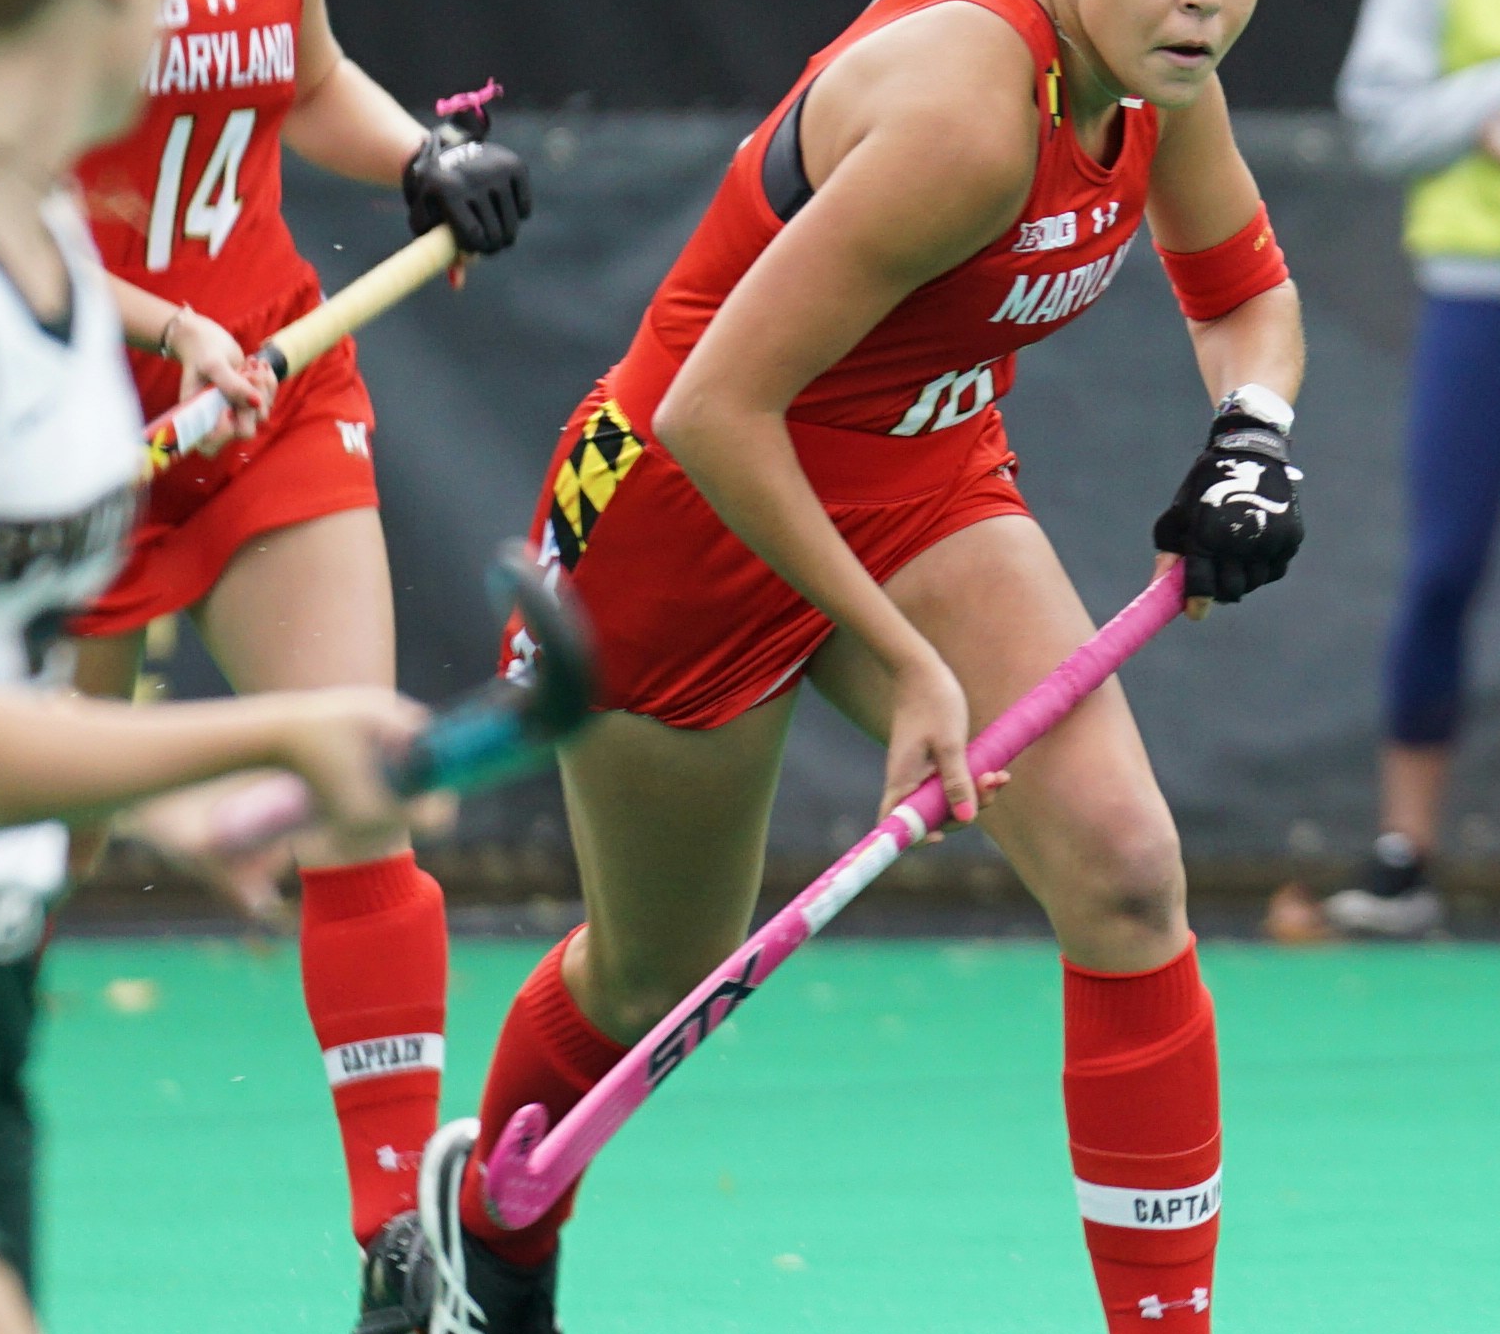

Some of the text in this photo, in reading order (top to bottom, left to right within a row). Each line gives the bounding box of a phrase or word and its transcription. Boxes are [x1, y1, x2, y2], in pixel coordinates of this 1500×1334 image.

[146, 107, 257, 273] 14
[340, 1036, 425, 1074] CAPTAIN
[645, 943, 767, 1093] STX
